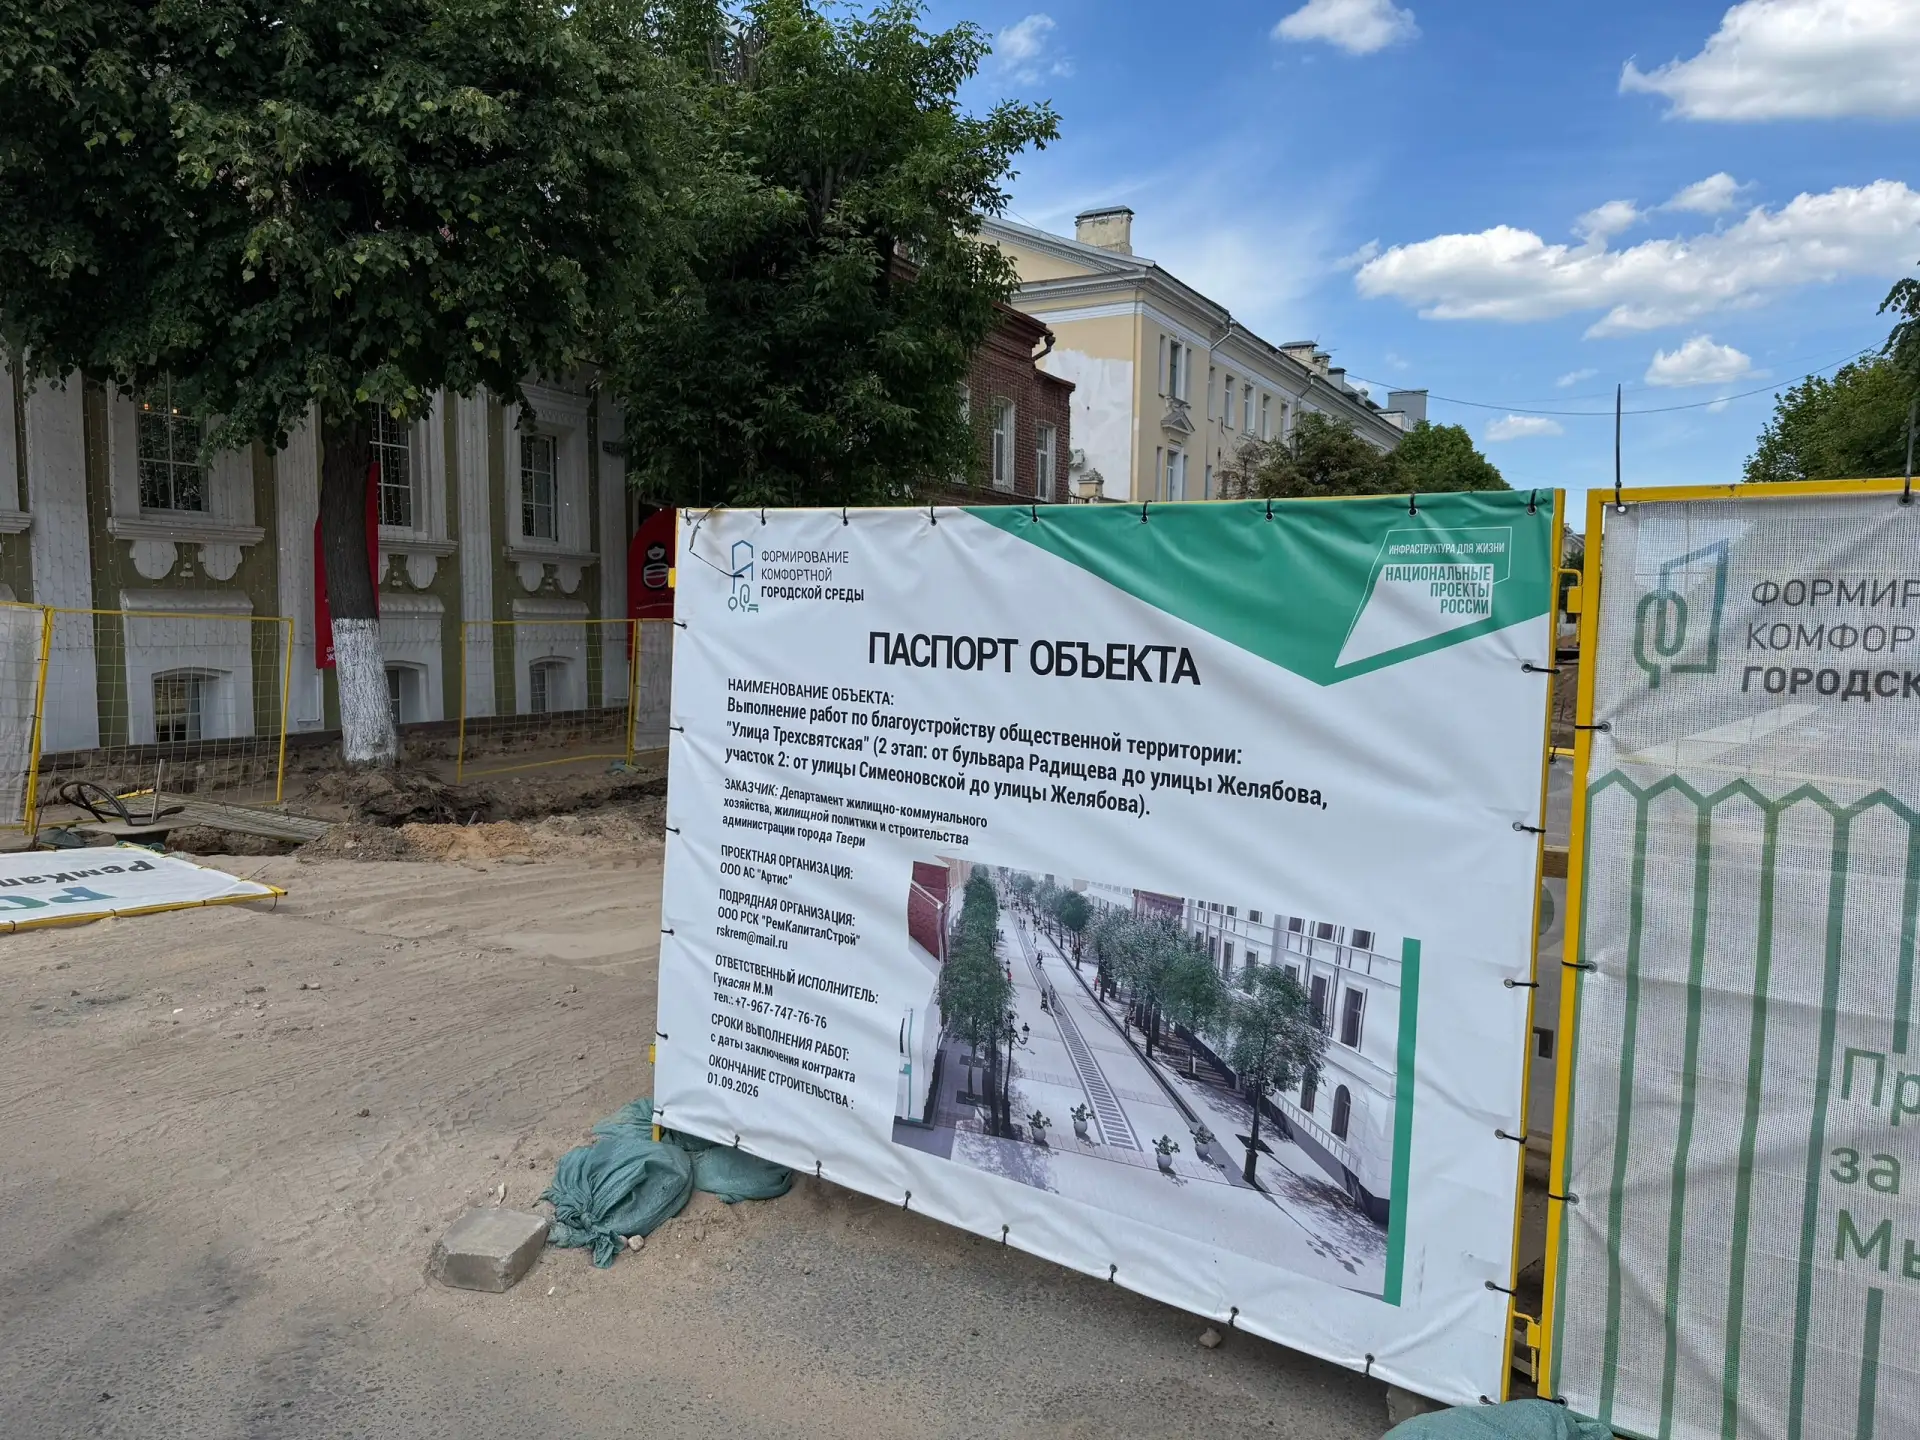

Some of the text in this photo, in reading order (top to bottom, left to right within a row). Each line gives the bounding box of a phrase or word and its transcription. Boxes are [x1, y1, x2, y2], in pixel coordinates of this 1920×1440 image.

[761, 550, 849, 564] ФОРМИРОВАНИЕ
[1389, 542, 1505, 555] ИНФРАСТРУКТУРА ДЛЯ ЖИЗНИ
[761, 566, 833, 582] КОМФОРТНОЙ
[1385, 566, 1491, 582] НАЦИОНАЛЬНЫЕ
[1430, 582, 1489, 598] ПРОЕКТЫ
[760, 584, 864, 602] ГОРОДСКОЙ СРЕДЫ
[1440, 599, 1489, 614] РОССИИ
[1752, 579, 1920, 608] ФОРМИР
[1747, 623, 1916, 652] КОМФОР
[869, 631, 1201, 685] ПАСПОРТ ОБЪЕКТА
[728, 678, 894, 706] НАИМЕНОВАНИЕ ОБЪЕКТА:
[1741, 666, 1920, 702] ГОРОДСК
[727, 696, 1242, 766] Выполнение работ по благоустройству общественной территории:
[726, 720, 1327, 810] "Улица Трехсвятская" (2 этап: от бульвара Радищева до улицы Желябова,
[724, 748, 1150, 819] участок 2: от улицы Симеоновской до улицы Желябова).
[724, 777, 988, 828] ЗАКАЗЧИК: Департамент жилищно-коммунального
[722, 815, 866, 849] администрации города Твери
[723, 798, 969, 846] хозяйства, жилищной политики и строительства
[720, 861, 793, 886] ООО АС "Артис"
[721, 844, 853, 880] ПРОЕКТНАЯ ОРГАНИЗАЦИЯ:
[719, 888, 856, 927] ПОДРЯДНАЯ ОРГАНИЗАЦИЯ:
[716, 924, 788, 950] rskrem@mail.ru
[717, 906, 861, 946] ООО РСК "РемКапиталСтрой"
[713, 971, 773, 997] Гукасян М.М
[715, 954, 879, 1004] ОТВЕТСТВЕННЫЙ ИСПОЛНИТЕЛЬ:
[735, 996, 827, 1029] +7-967-747-76-76
[711, 1013, 849, 1062] СРОКИ ВЫПОЛНЕНИЯ РАБОТ:
[708, 1054, 767, 1081] ОКОНЧАНИЕ
[710, 1033, 856, 1083] с даты заключения контракта
[707, 1071, 759, 1098] 01.09.2026
[1841, 1047, 1920, 1127] Пр
[1830, 1147, 1900, 1195] за
